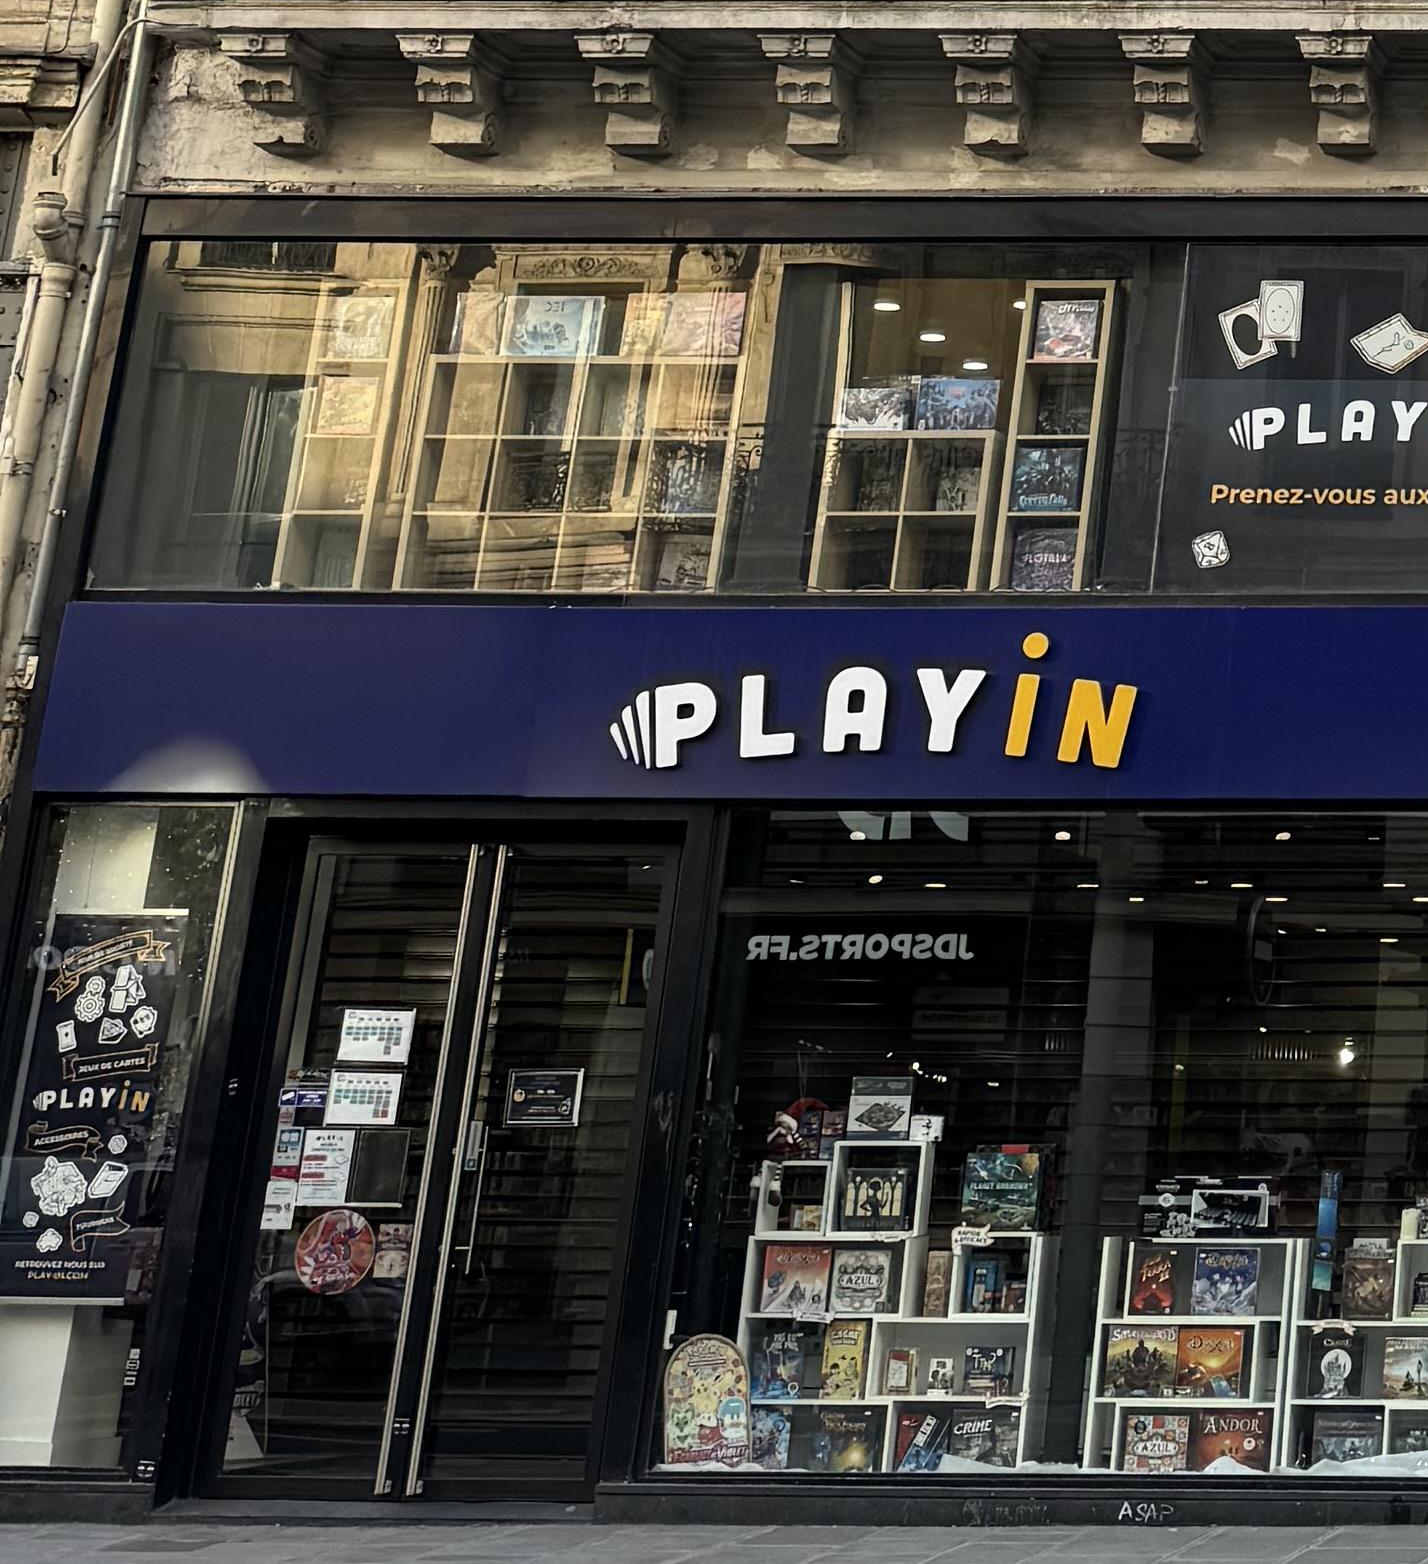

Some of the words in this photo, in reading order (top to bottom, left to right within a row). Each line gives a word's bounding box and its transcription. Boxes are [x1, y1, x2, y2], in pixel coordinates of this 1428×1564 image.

[1210, 484, 1376, 505] Prenez-vous
[845, 1274, 875, 1285] AZUL
[953, 1419, 993, 1436] CRIME
[1204, 1417, 1262, 1434] ANDOR
[1139, 1442, 1171, 1453] AZUL
[1118, 1501, 1174, 1523] ASAP
